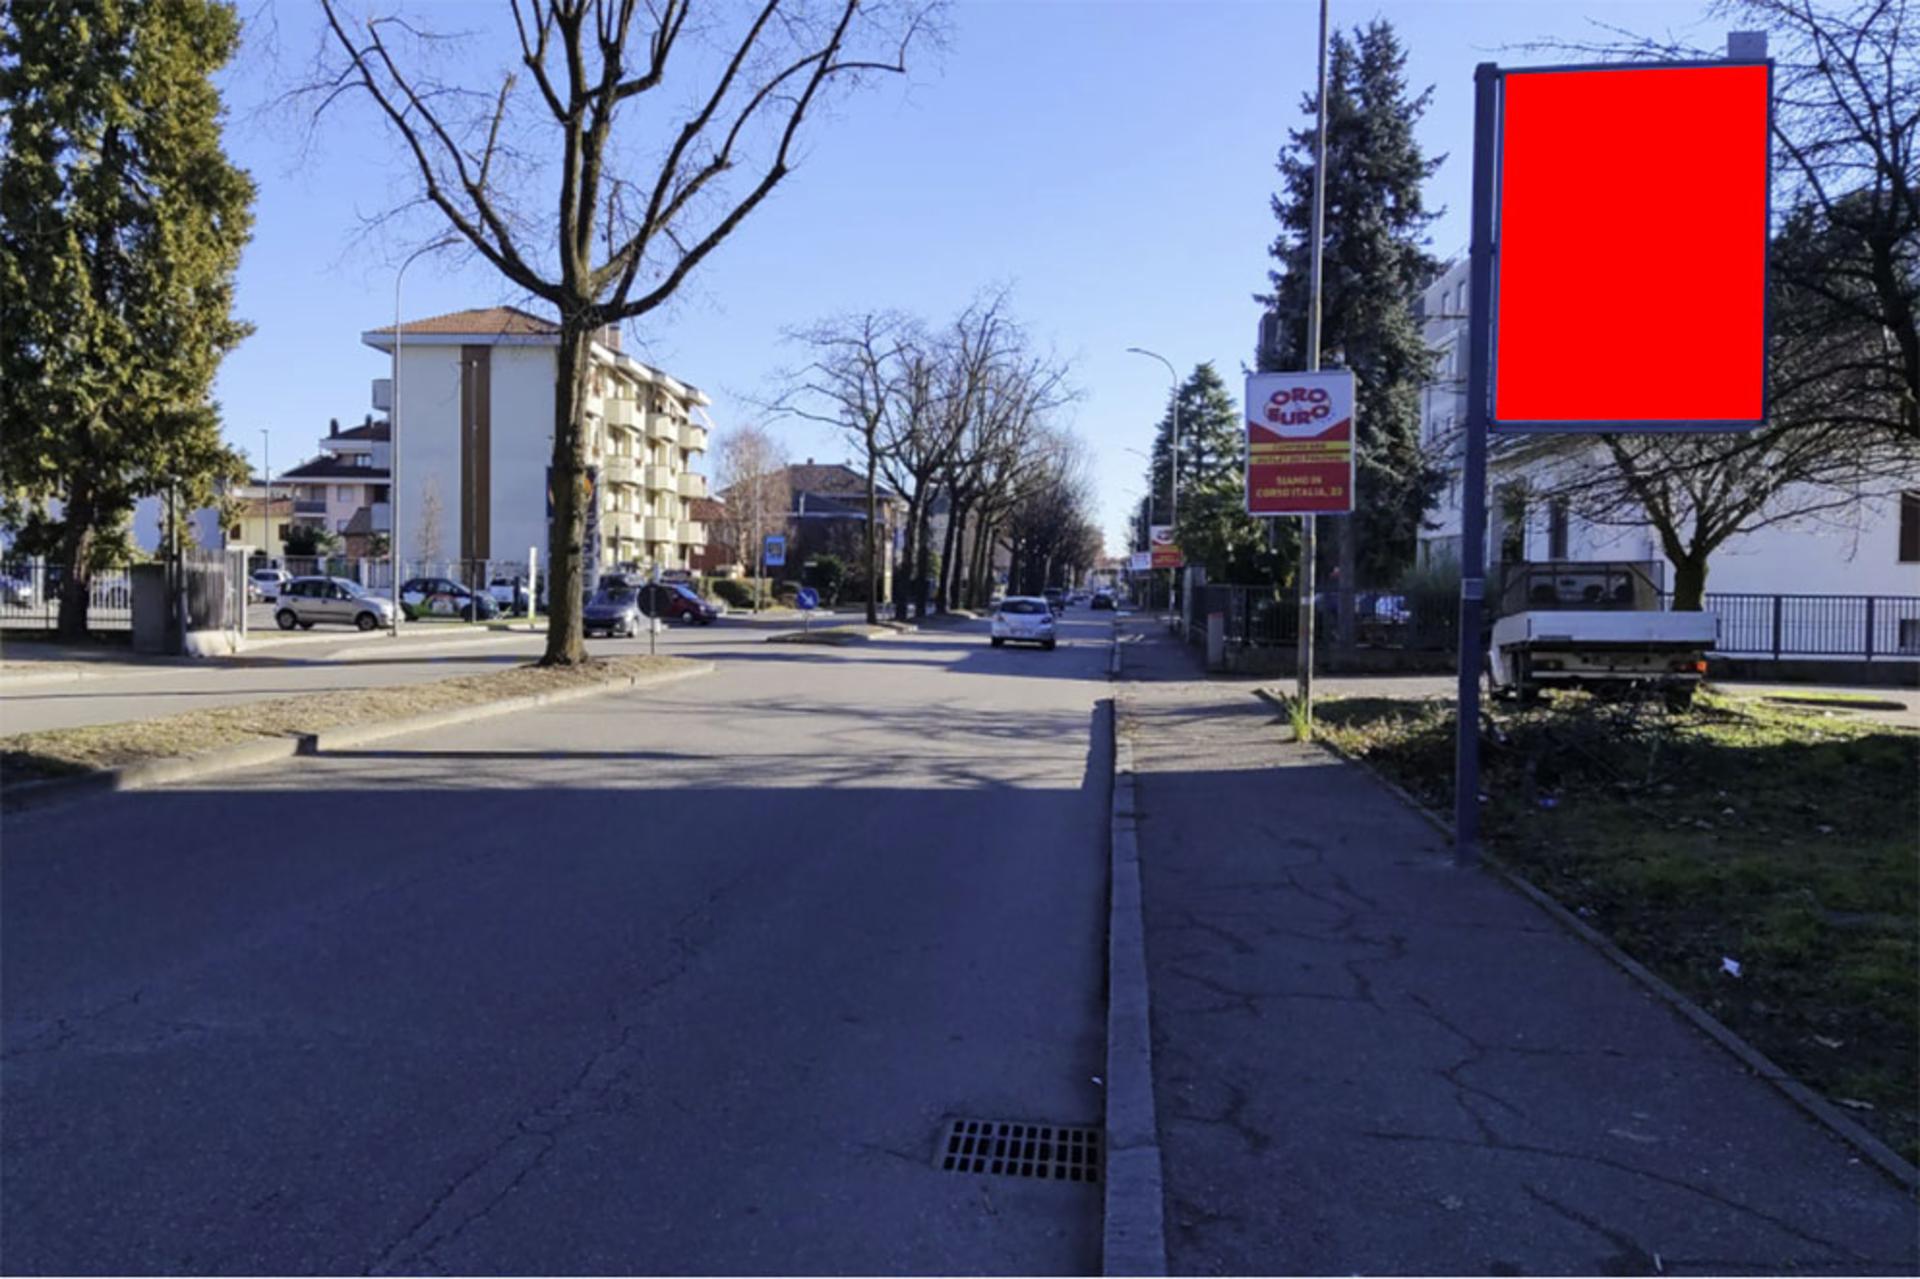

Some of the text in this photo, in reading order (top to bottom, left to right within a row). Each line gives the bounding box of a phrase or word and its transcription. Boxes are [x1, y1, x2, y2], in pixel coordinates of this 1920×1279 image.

[1270, 387, 1328, 405] ORO
[1267, 404, 1330, 425] EURO
[1256, 487, 1289, 498] CORSO
